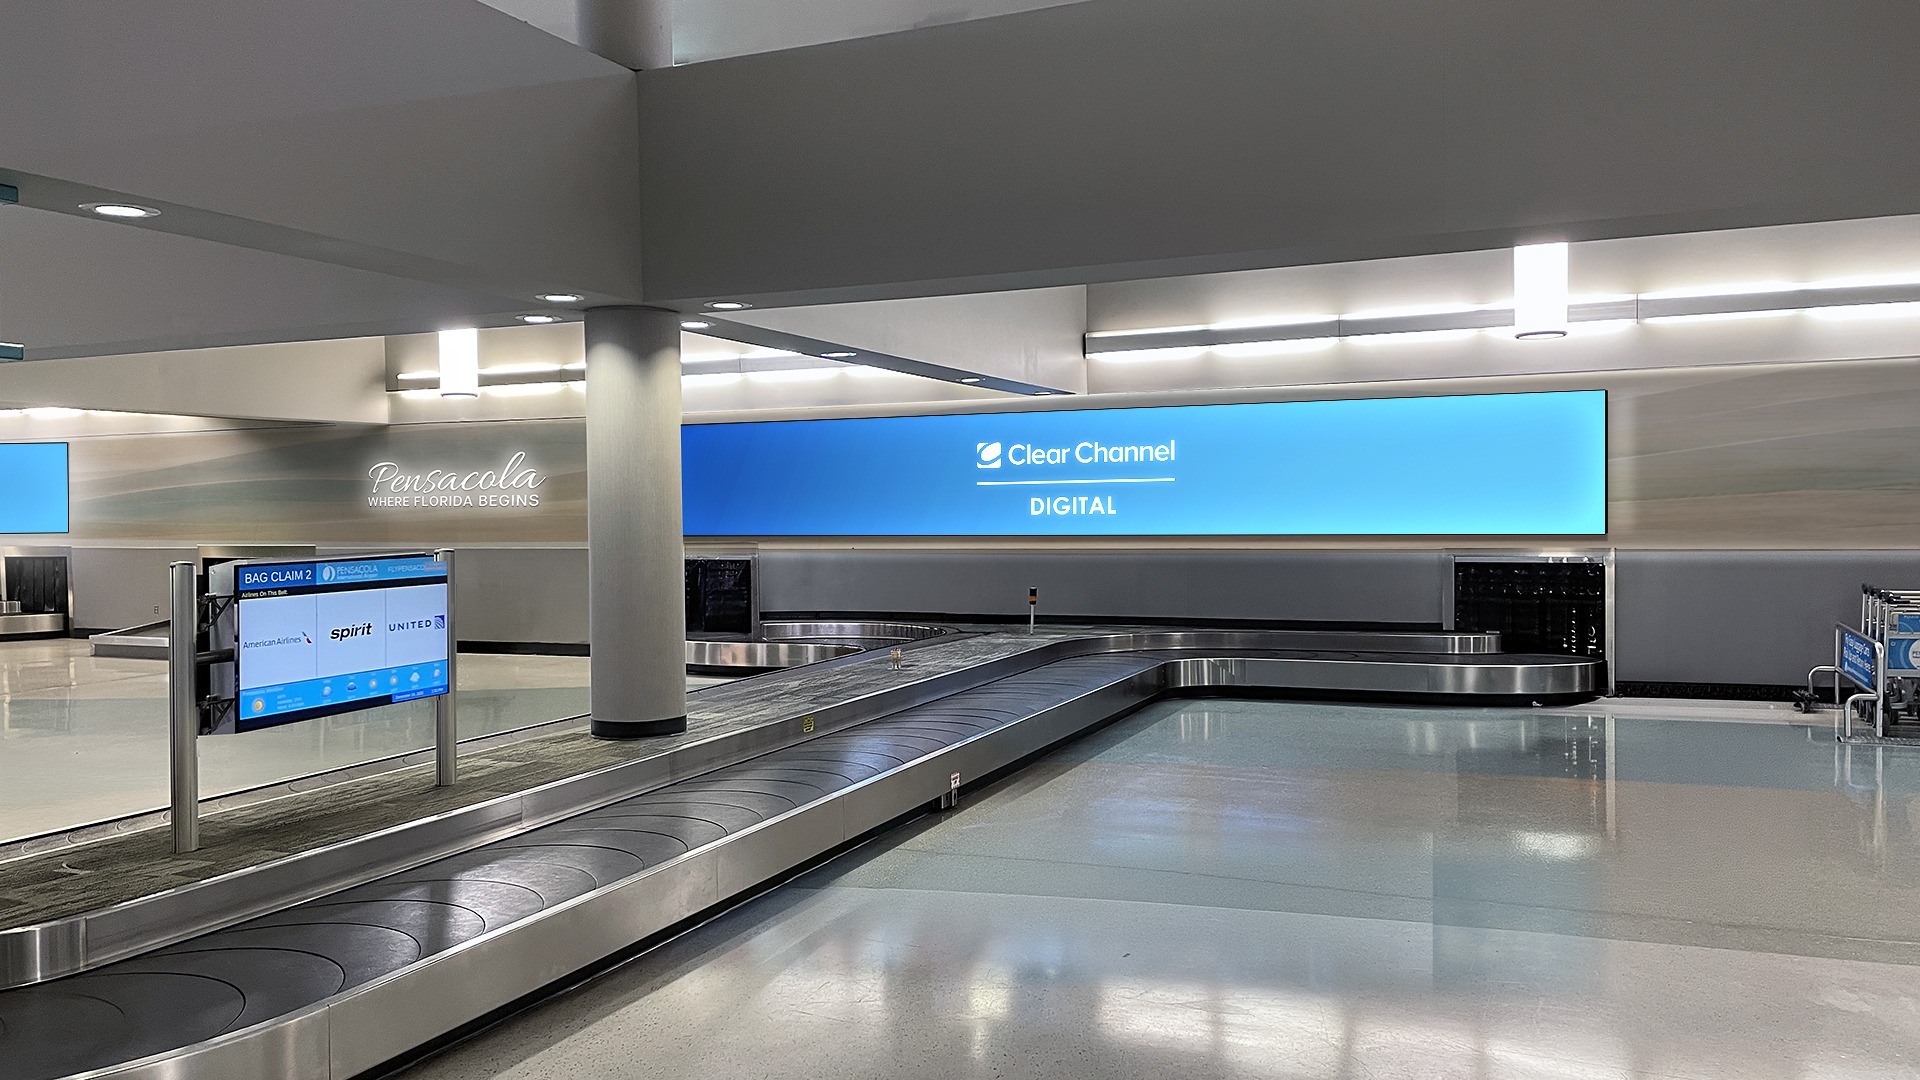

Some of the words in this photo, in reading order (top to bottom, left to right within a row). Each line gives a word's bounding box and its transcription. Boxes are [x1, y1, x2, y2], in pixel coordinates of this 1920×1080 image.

[1008, 443, 1070, 466] Clear
[1075, 439, 1176, 463] Channel
[368, 452, 546, 494] Pensacola
[368, 497, 410, 507] WHERE
[414, 496, 473, 507] FLORIDA
[478, 494, 540, 507] BEGINS
[1030, 496, 1117, 516] DIGITAL
[244, 572, 268, 584] BAG
[270, 571, 303, 582] CLAIM
[305, 569, 312, 580] 2
[336, 564, 378, 575] PENSACOLA
[330, 622, 372, 642] spirit
[388, 619, 432, 632] UNITED
[242, 638, 276, 649] American
[276, 636, 302, 645] Airlines
